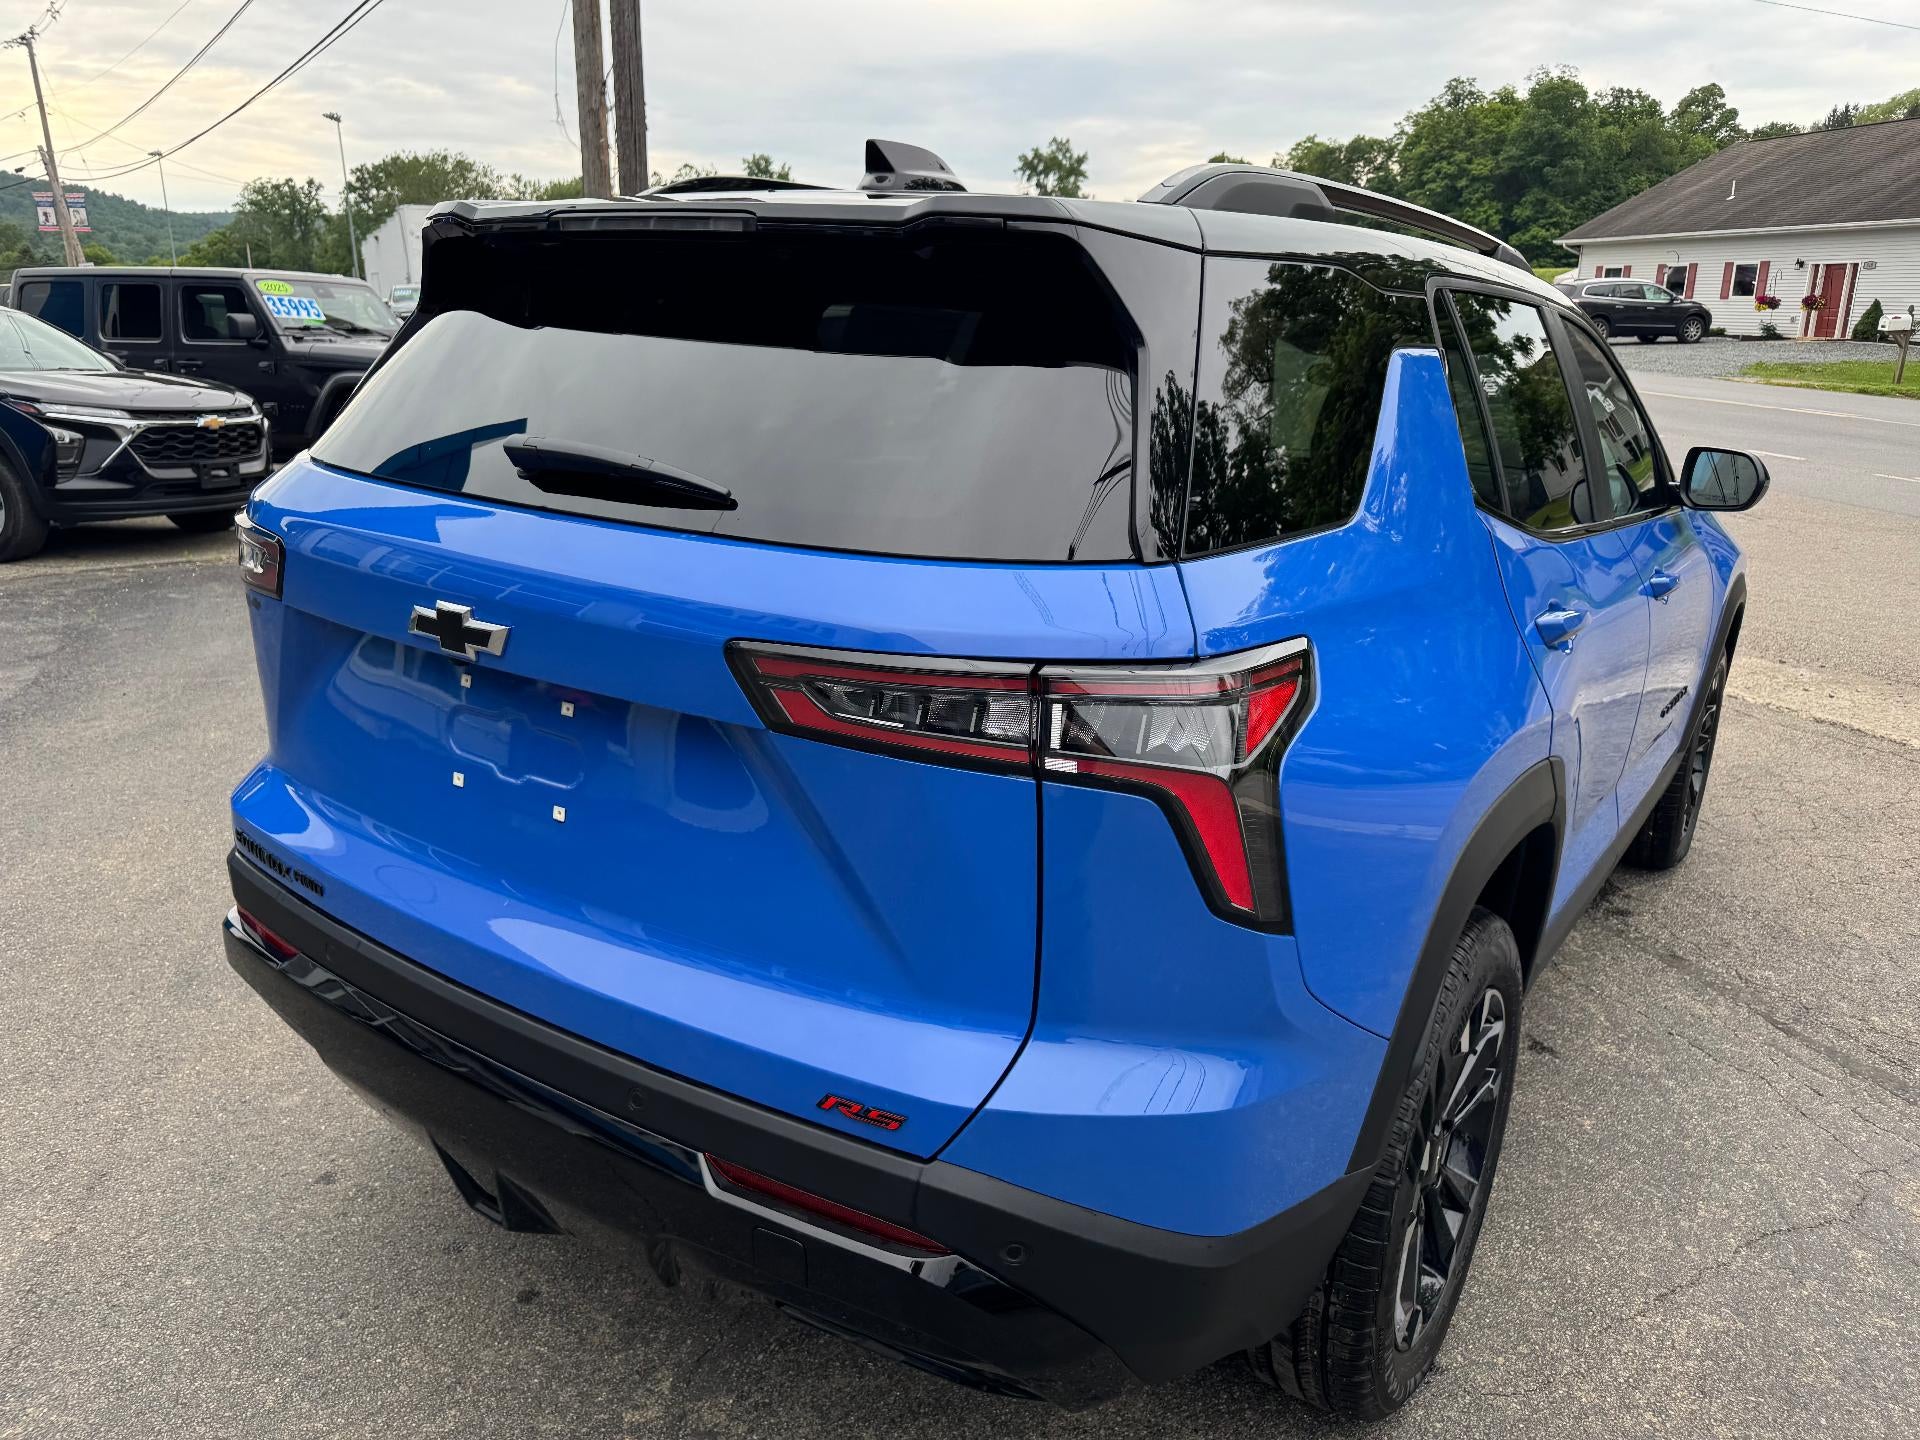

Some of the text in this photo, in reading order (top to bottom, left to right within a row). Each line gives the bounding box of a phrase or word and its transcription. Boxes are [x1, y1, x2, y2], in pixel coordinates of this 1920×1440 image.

[264, 282, 288, 293] 2025
[266, 296, 321, 317] 35995
[816, 1093, 908, 1130] RS
